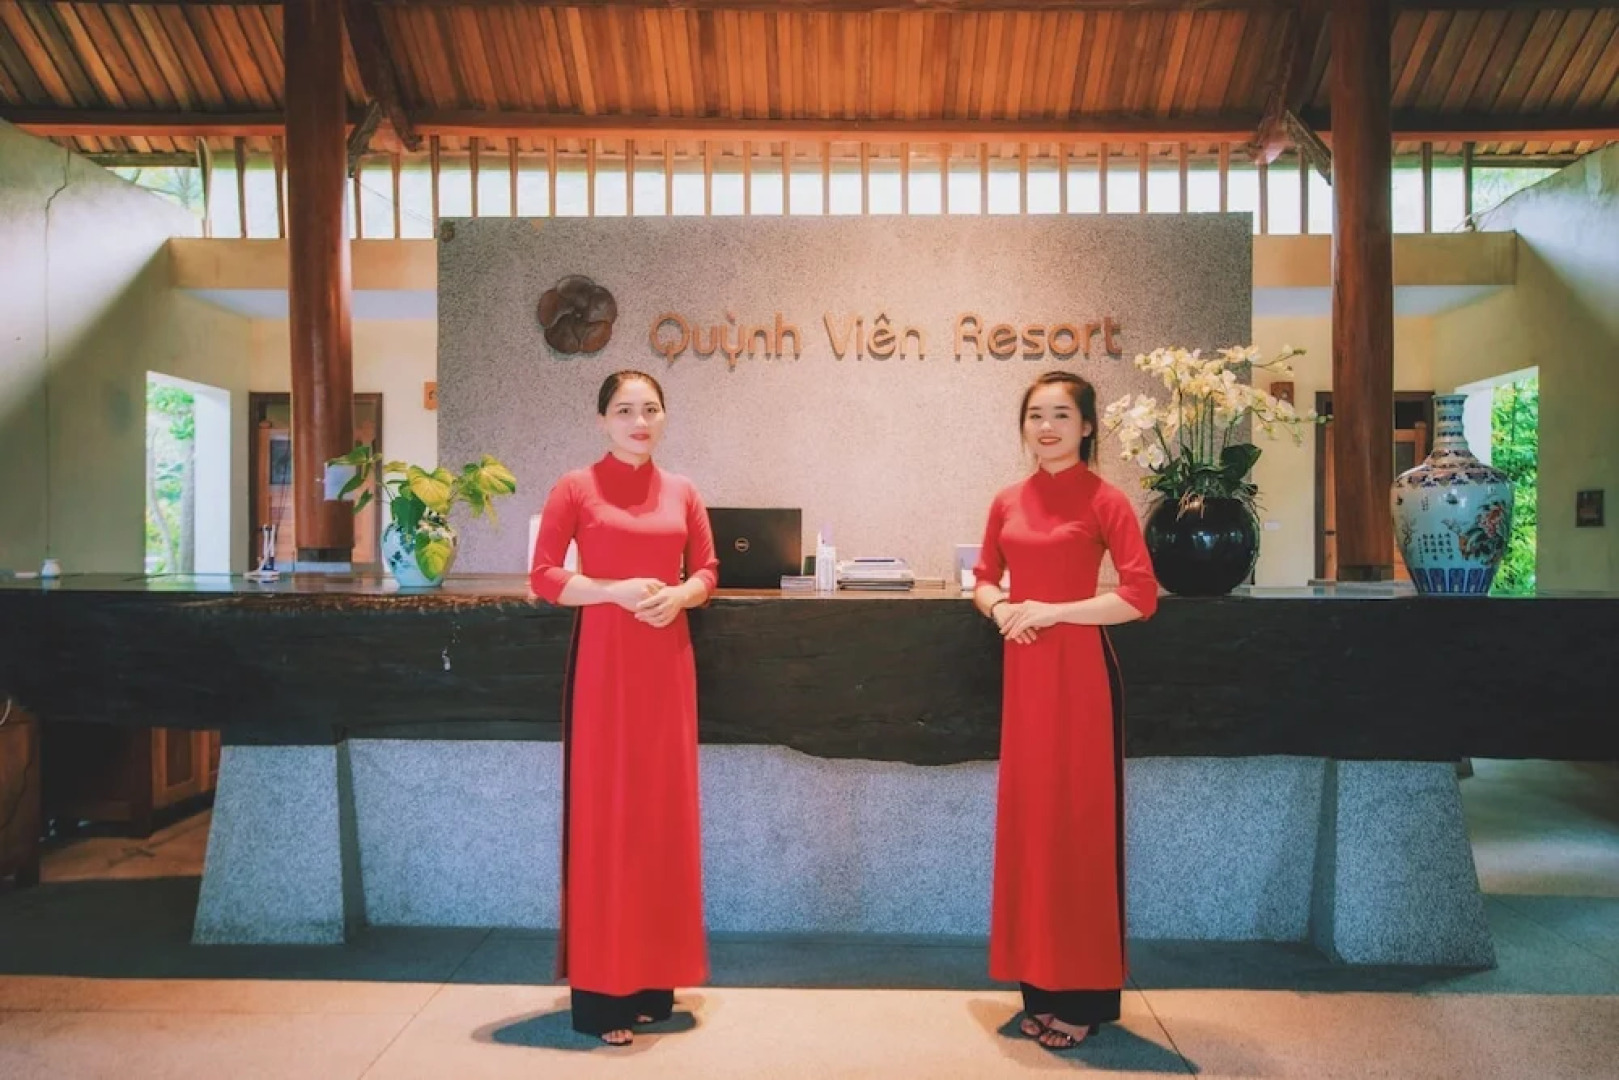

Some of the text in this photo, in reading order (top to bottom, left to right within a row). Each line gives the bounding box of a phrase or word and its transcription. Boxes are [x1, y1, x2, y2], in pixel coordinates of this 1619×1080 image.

[650, 311, 1122, 368] Quỳnh Viên Resort
